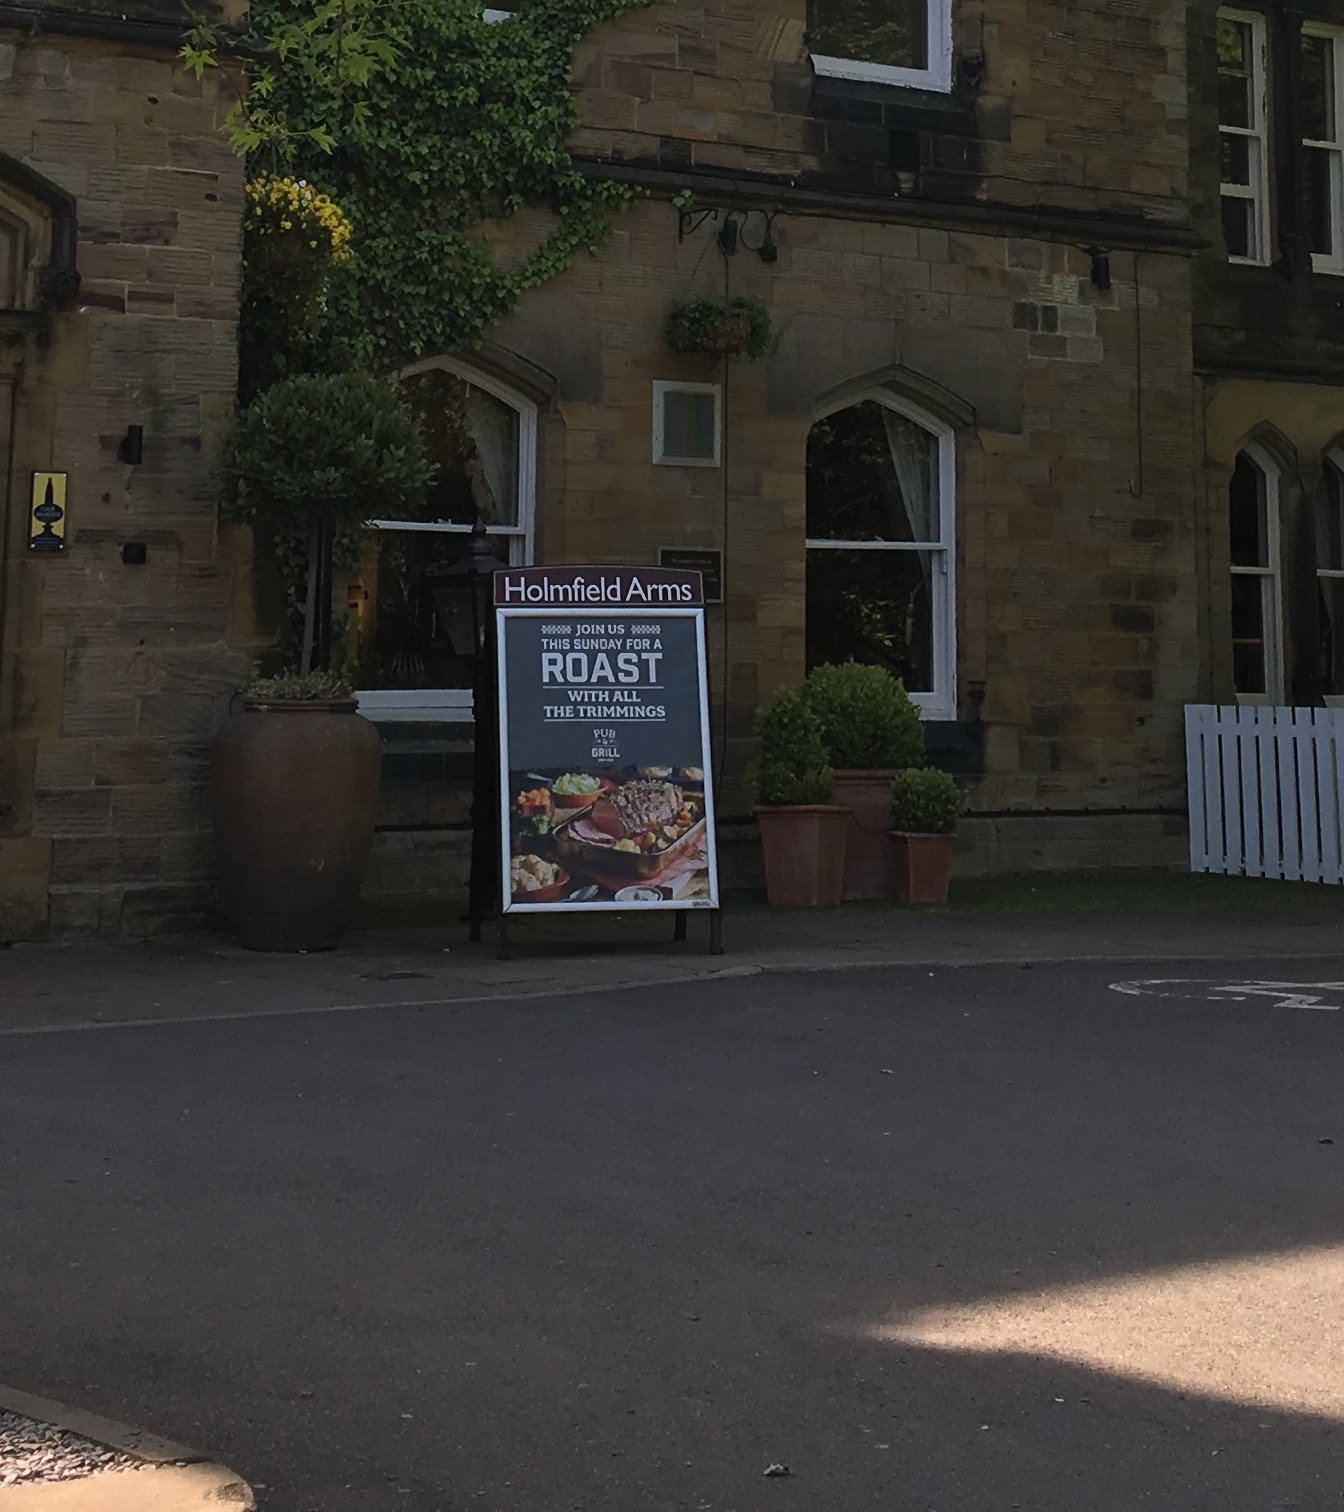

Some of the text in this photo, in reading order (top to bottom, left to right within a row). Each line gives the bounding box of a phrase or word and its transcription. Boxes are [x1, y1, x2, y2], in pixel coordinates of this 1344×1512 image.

[504, 576, 693, 602] Holmfield Arms
[575, 624, 625, 636] JOIN US
[541, 638, 663, 650] THIS SUNDAY FOR A
[541, 652, 663, 683] ROAST
[567, 690, 641, 702] WITH ALL
[543, 705, 666, 718] THE TRIMMINGS
[593, 728, 616, 739] PUB
[591, 747, 621, 758] GRILL
